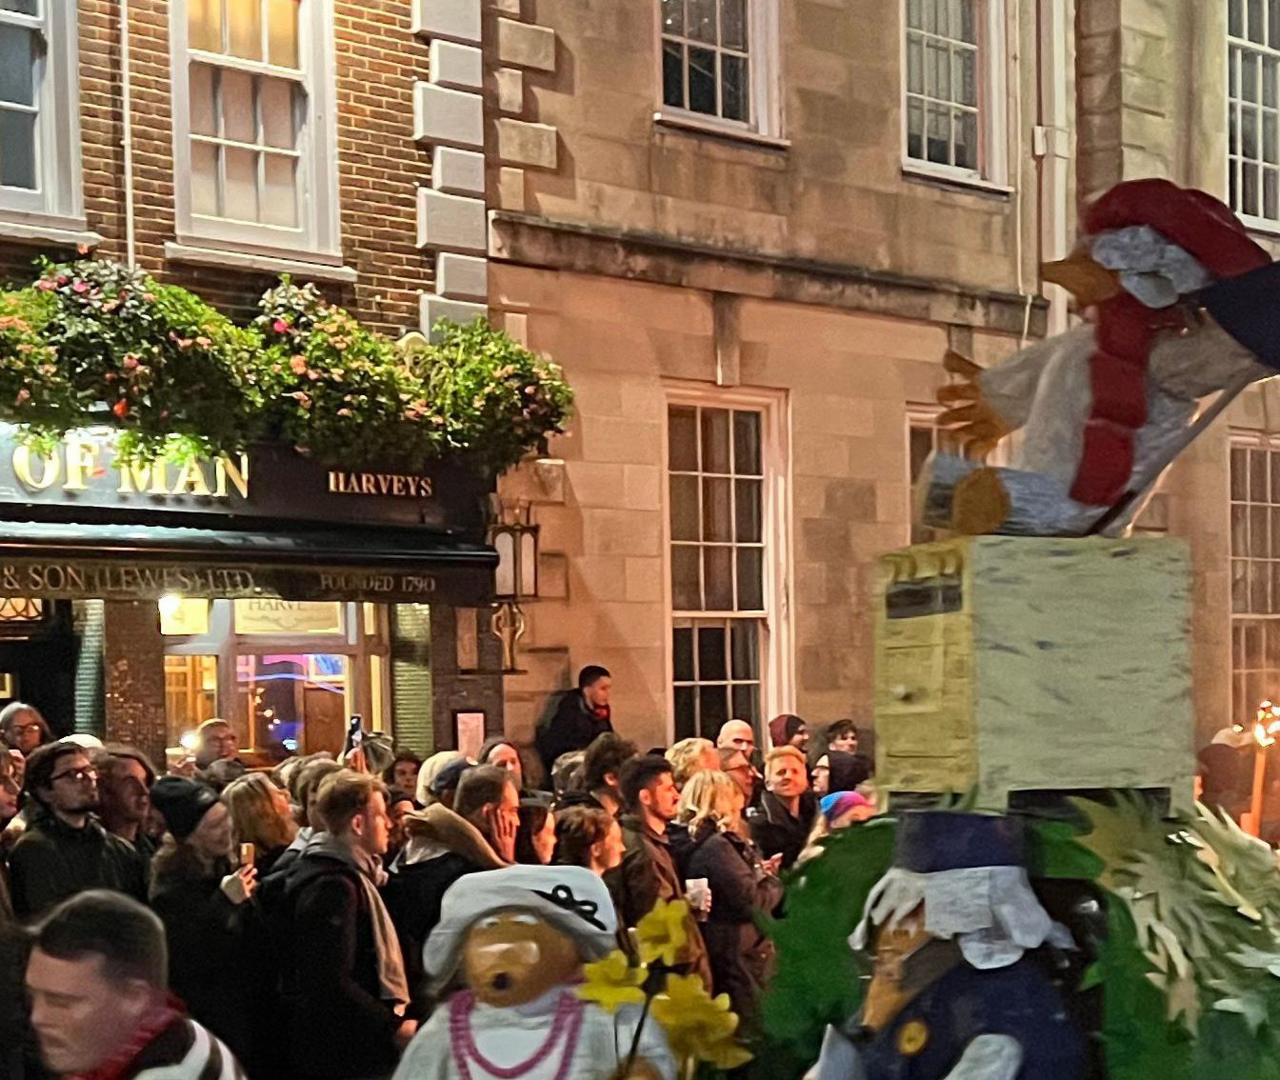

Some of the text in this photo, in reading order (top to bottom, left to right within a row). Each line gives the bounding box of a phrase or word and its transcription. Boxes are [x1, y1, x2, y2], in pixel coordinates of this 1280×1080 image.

[12, 437, 100, 490] OF
[117, 446, 249, 499] MAN
[328, 471, 432, 497] HARVEYS
[3, 564, 21, 590] &
[28, 564, 86, 592] SON
[401, 576, 436, 593] 1790
